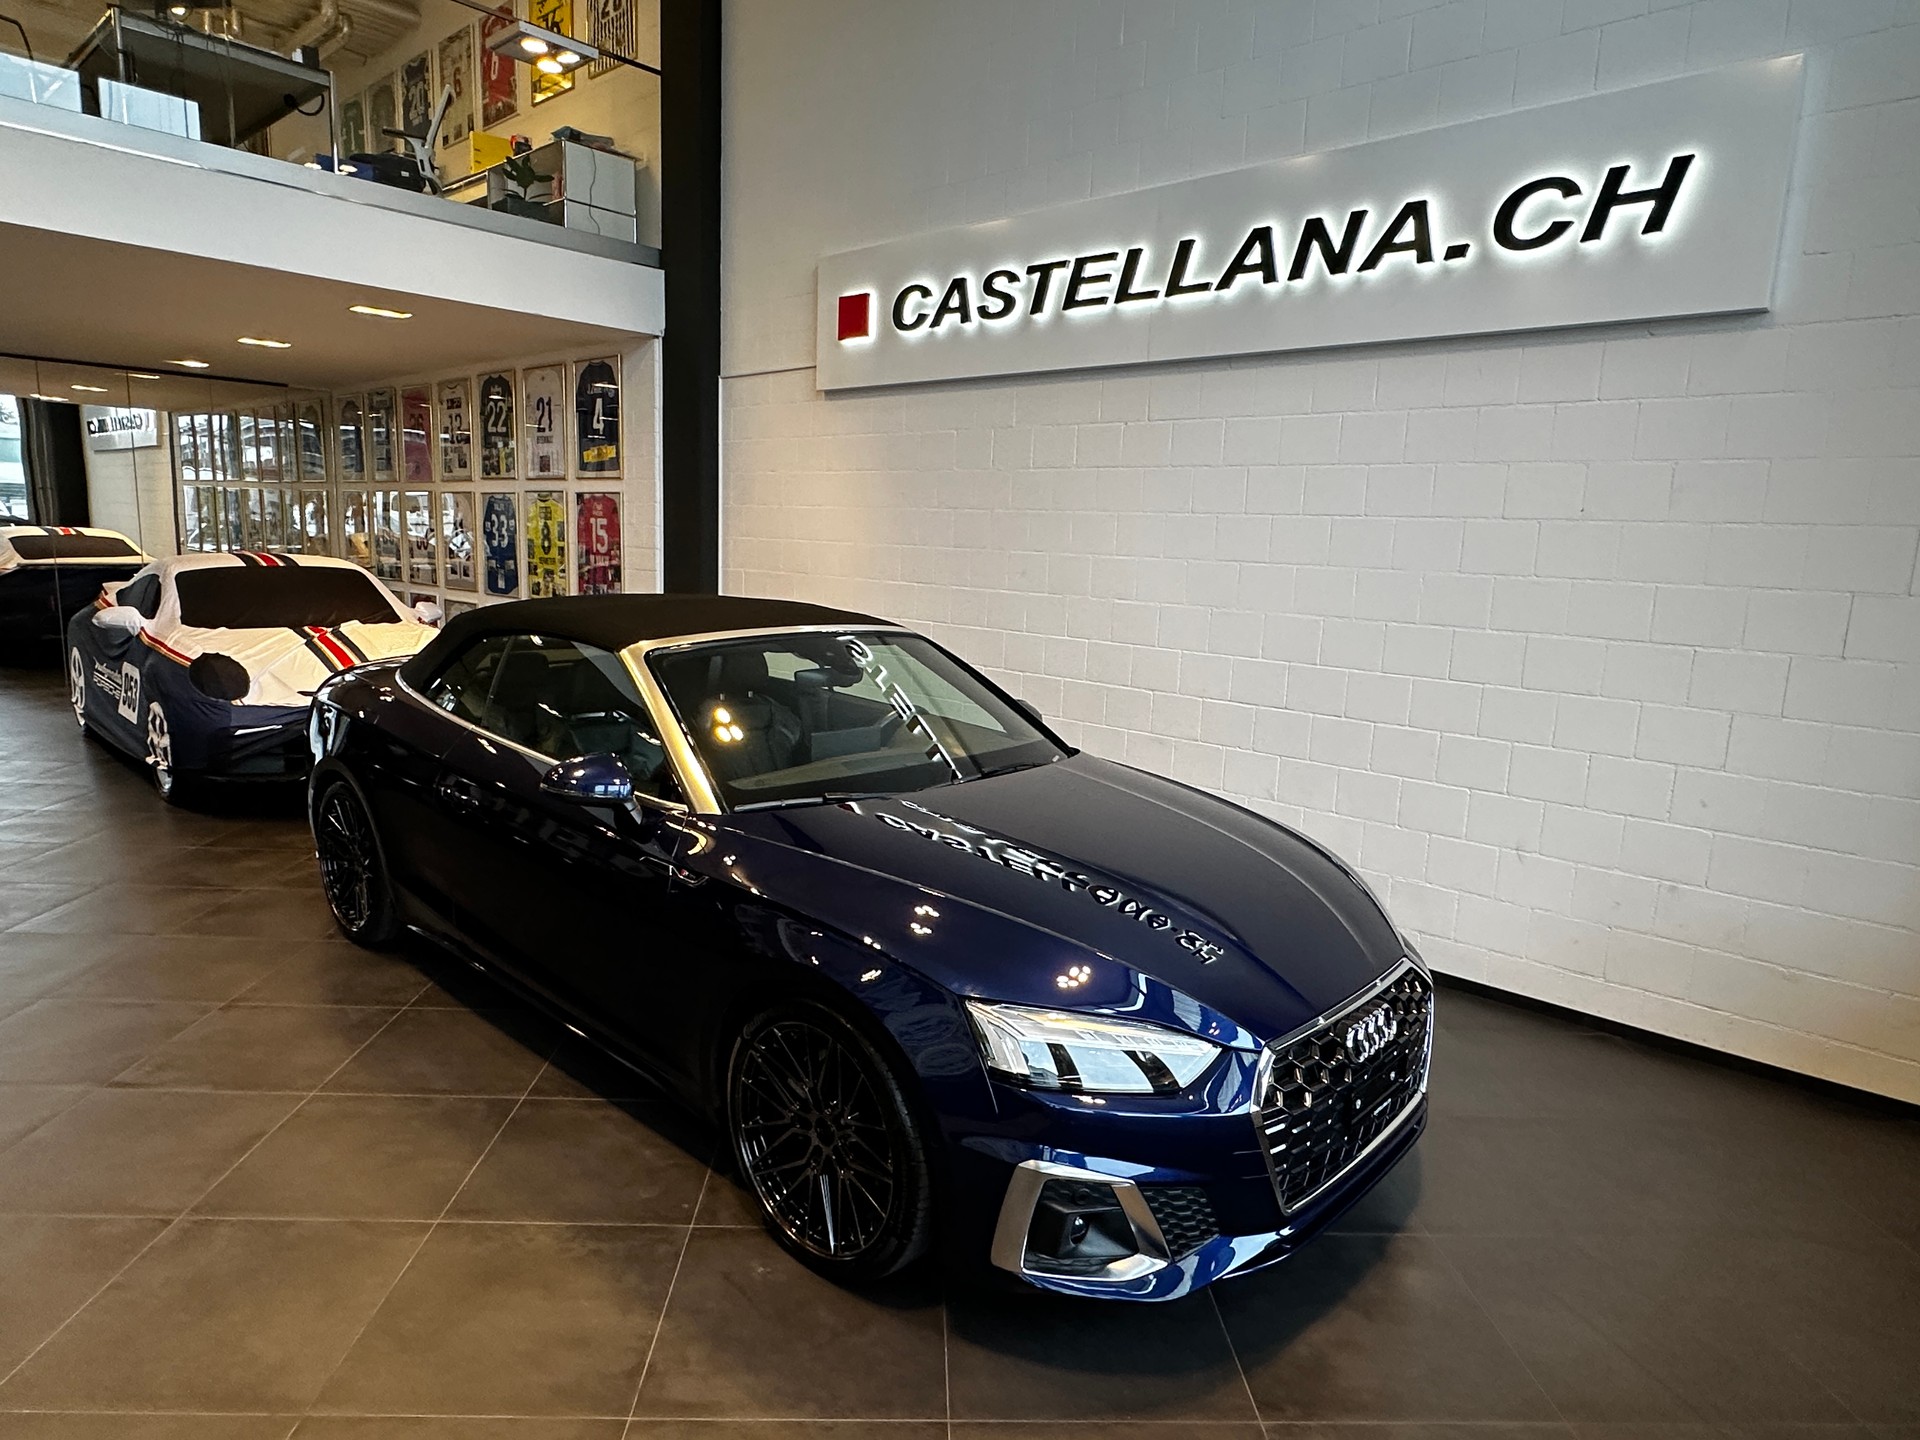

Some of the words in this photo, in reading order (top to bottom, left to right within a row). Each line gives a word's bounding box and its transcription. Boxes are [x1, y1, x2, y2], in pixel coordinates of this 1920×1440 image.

[892, 153, 1697, 332] CASTELLANA.CH
[487, 401, 507, 433] 22
[536, 396, 553, 433] 21
[593, 398, 604, 435] 4
[491, 513, 509, 549] 33
[589, 518, 609, 554] 15
[122, 672, 139, 713] 953
